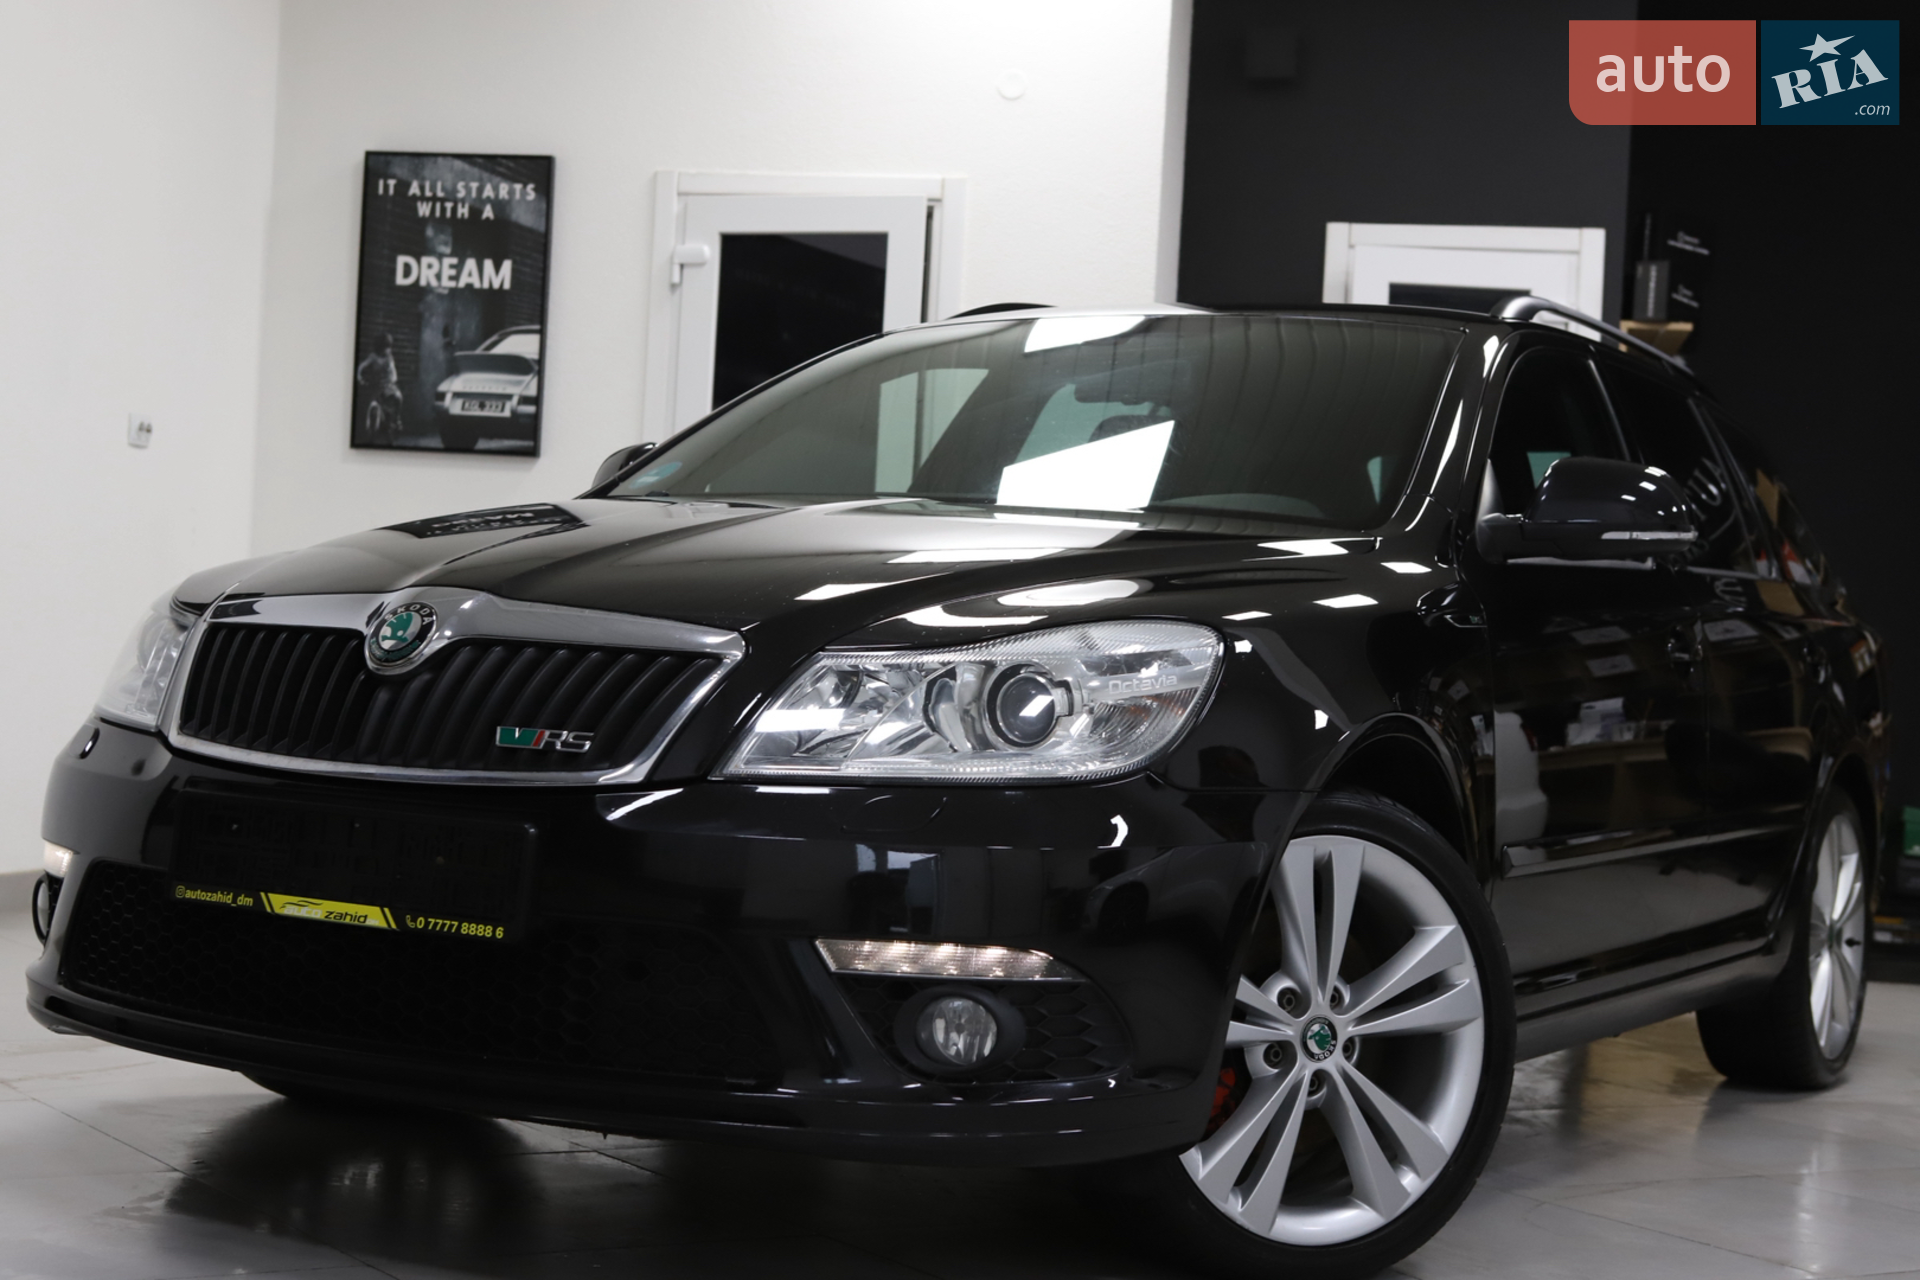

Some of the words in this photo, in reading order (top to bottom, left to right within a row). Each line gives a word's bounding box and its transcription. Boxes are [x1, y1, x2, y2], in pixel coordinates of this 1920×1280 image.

[378, 178, 397, 197] IT
[408, 180, 445, 198] ALL
[456, 180, 537, 201] STARTS
[417, 201, 470, 219] WITH
[482, 202, 495, 220] A
[395, 255, 513, 290] DREAM
[1108, 674, 1178, 694] Octavia
[416, 916, 426, 929] 0
[427, 918, 460, 933] 7777
[460, 922, 493, 938] 8888
[495, 926, 504, 939] 6
